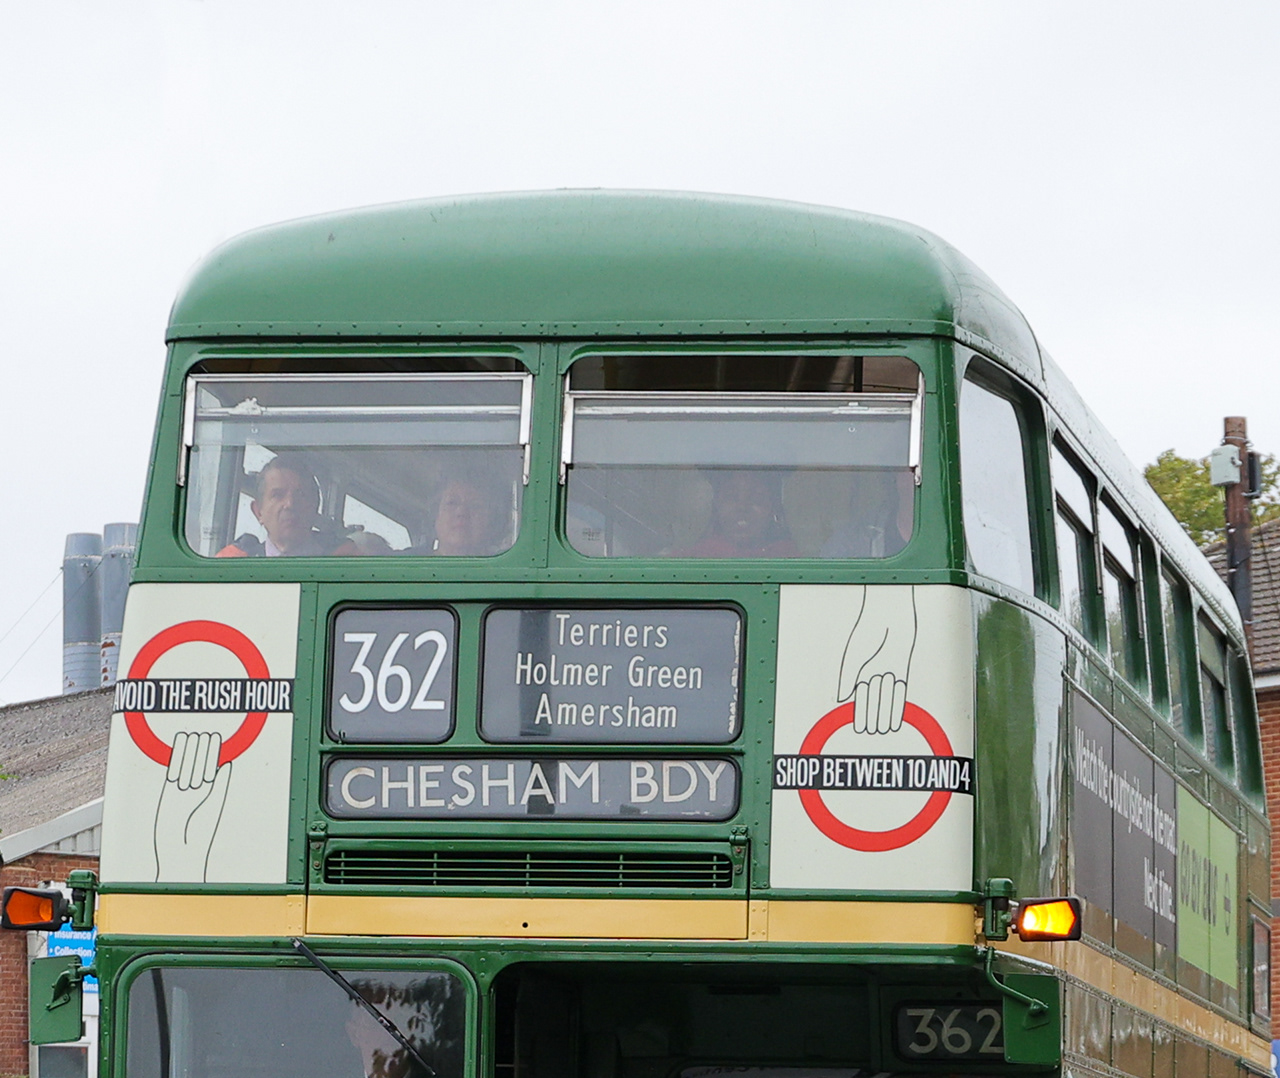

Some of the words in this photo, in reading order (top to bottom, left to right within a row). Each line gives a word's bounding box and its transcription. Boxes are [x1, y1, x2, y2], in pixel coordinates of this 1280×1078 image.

[556, 614, 668, 648] Terriers
[339, 630, 448, 713] 362
[515, 652, 613, 687] Holmer
[628, 655, 703, 690] Green
[159, 681, 192, 711] THE
[194, 681, 241, 711] RUSH
[245, 681, 291, 711] HOUR
[534, 693, 677, 728] Amersham
[341, 762, 600, 808] CHESHAM
[630, 761, 728, 803] BDY
[776, 757, 820, 787] SHOP
[822, 758, 904, 788] BETWEEN
[907, 758, 925, 788] 10
[926, 759, 960, 790] AND
[960, 761, 971, 791] 4
[906, 1008, 1004, 1055] 362
